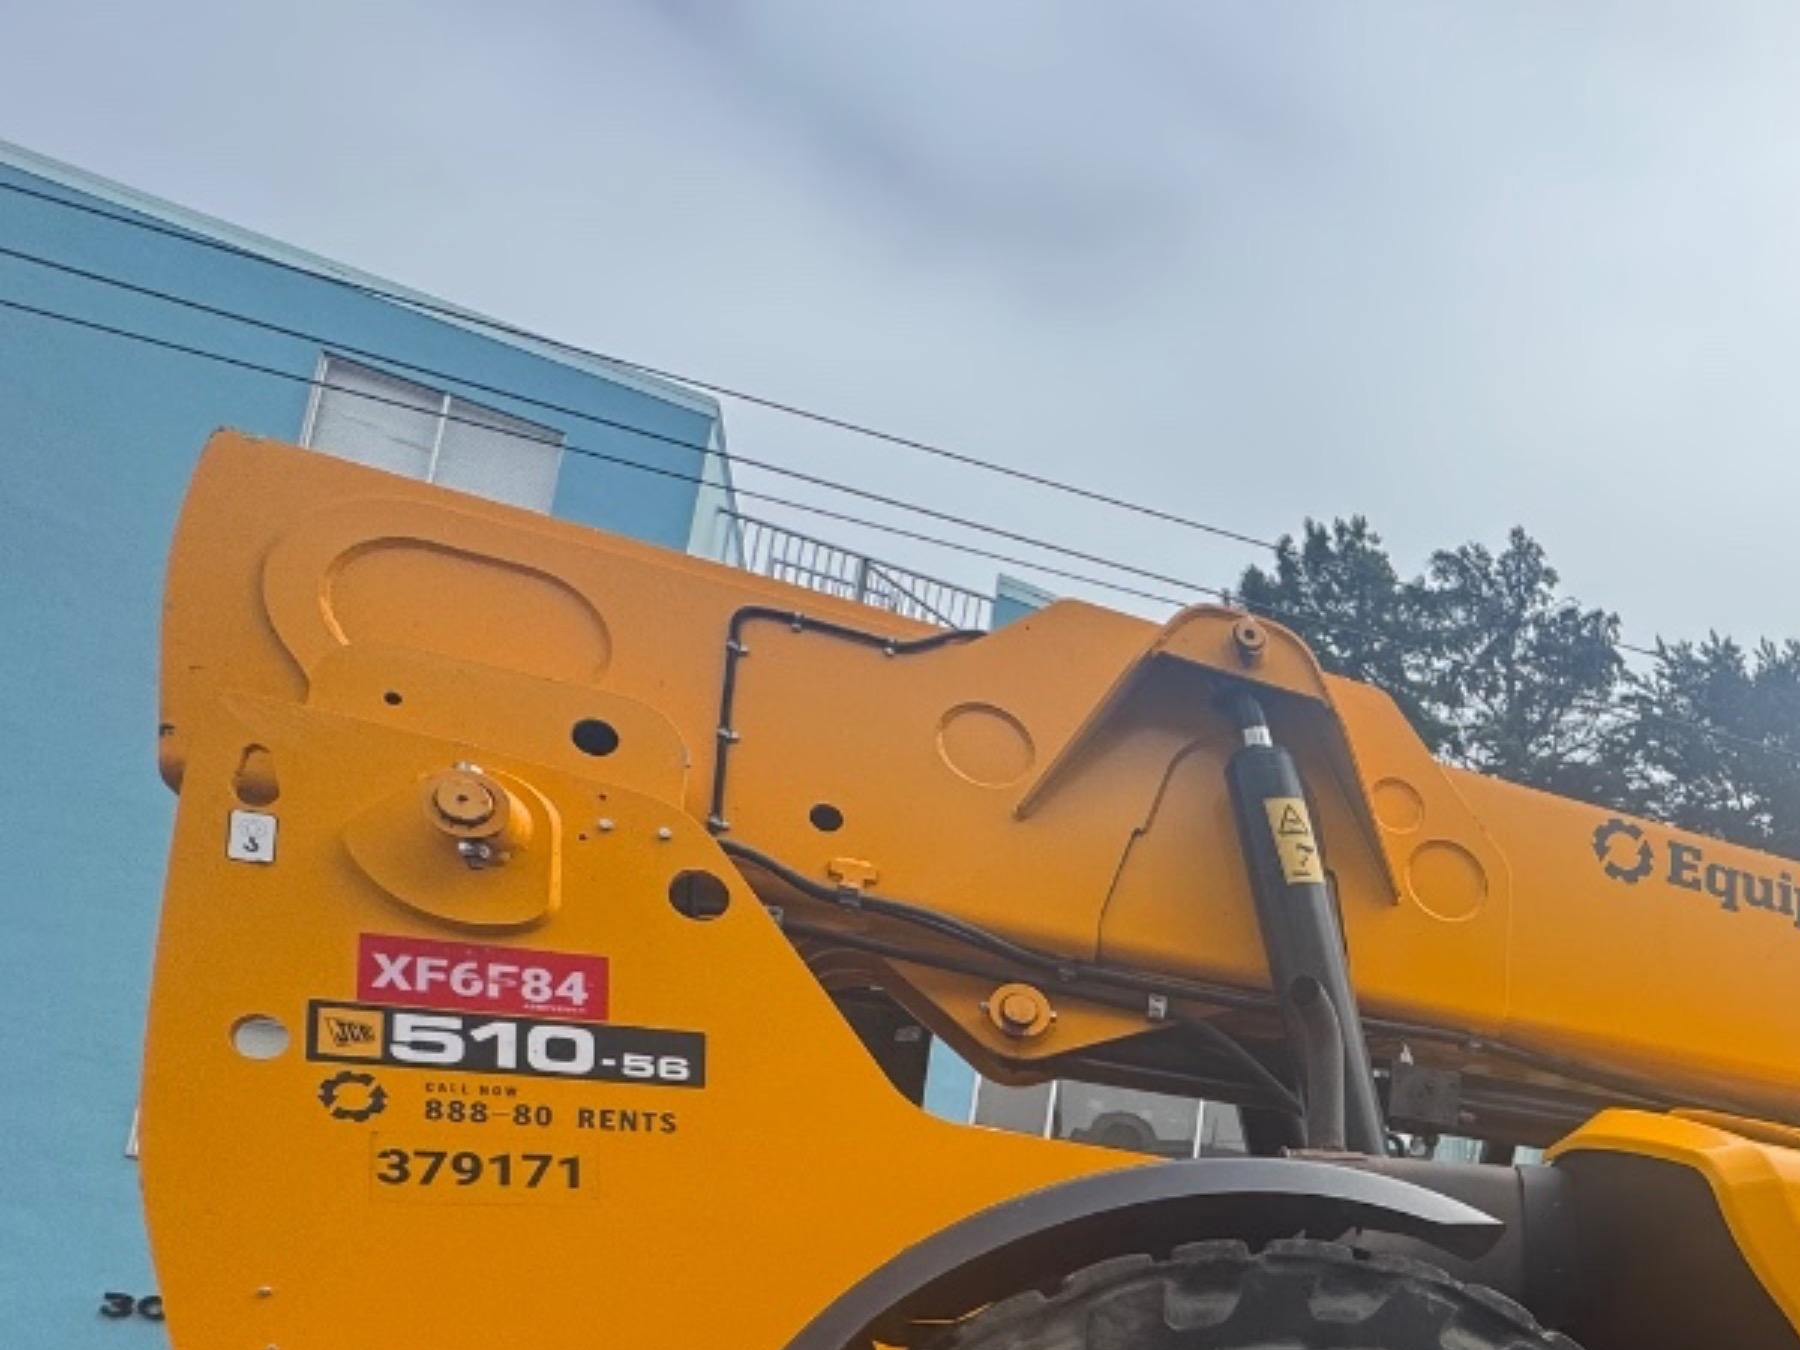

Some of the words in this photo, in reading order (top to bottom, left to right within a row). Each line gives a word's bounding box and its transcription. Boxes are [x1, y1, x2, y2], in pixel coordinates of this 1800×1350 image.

[370, 951, 590, 1007] XF6F84
[388, 1012, 691, 1082] 510-56
[424, 1082, 470, 1096] CALL
[479, 1084, 518, 1098] NOW
[424, 1099, 554, 1127] 888-80
[577, 1108, 678, 1134] RENTS
[376, 1148, 581, 1190] 379171
